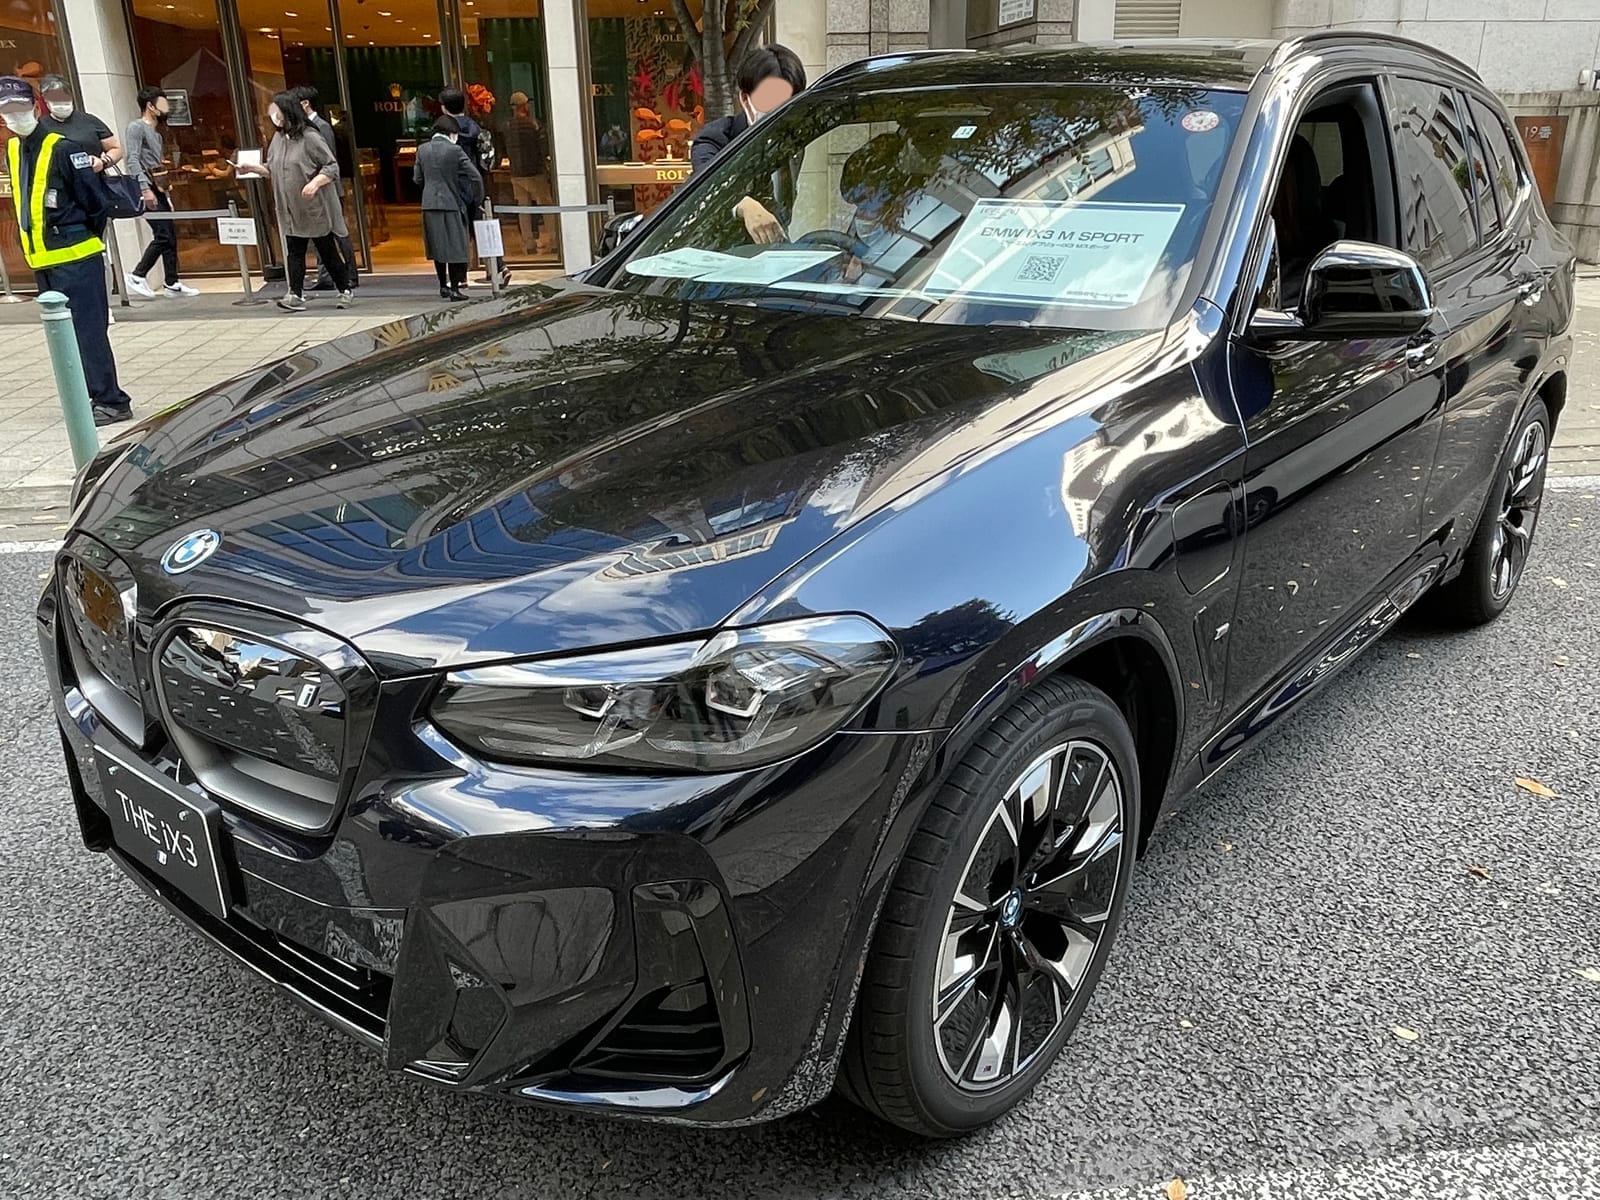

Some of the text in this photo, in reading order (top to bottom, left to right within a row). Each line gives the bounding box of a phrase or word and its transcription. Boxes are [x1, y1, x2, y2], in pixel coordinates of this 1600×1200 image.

[980, 226, 1024, 239] BMW
[1057, 230, 1076, 241] M
[1078, 231, 1145, 244] SPORT
[115, 788, 198, 867] THE iX3
